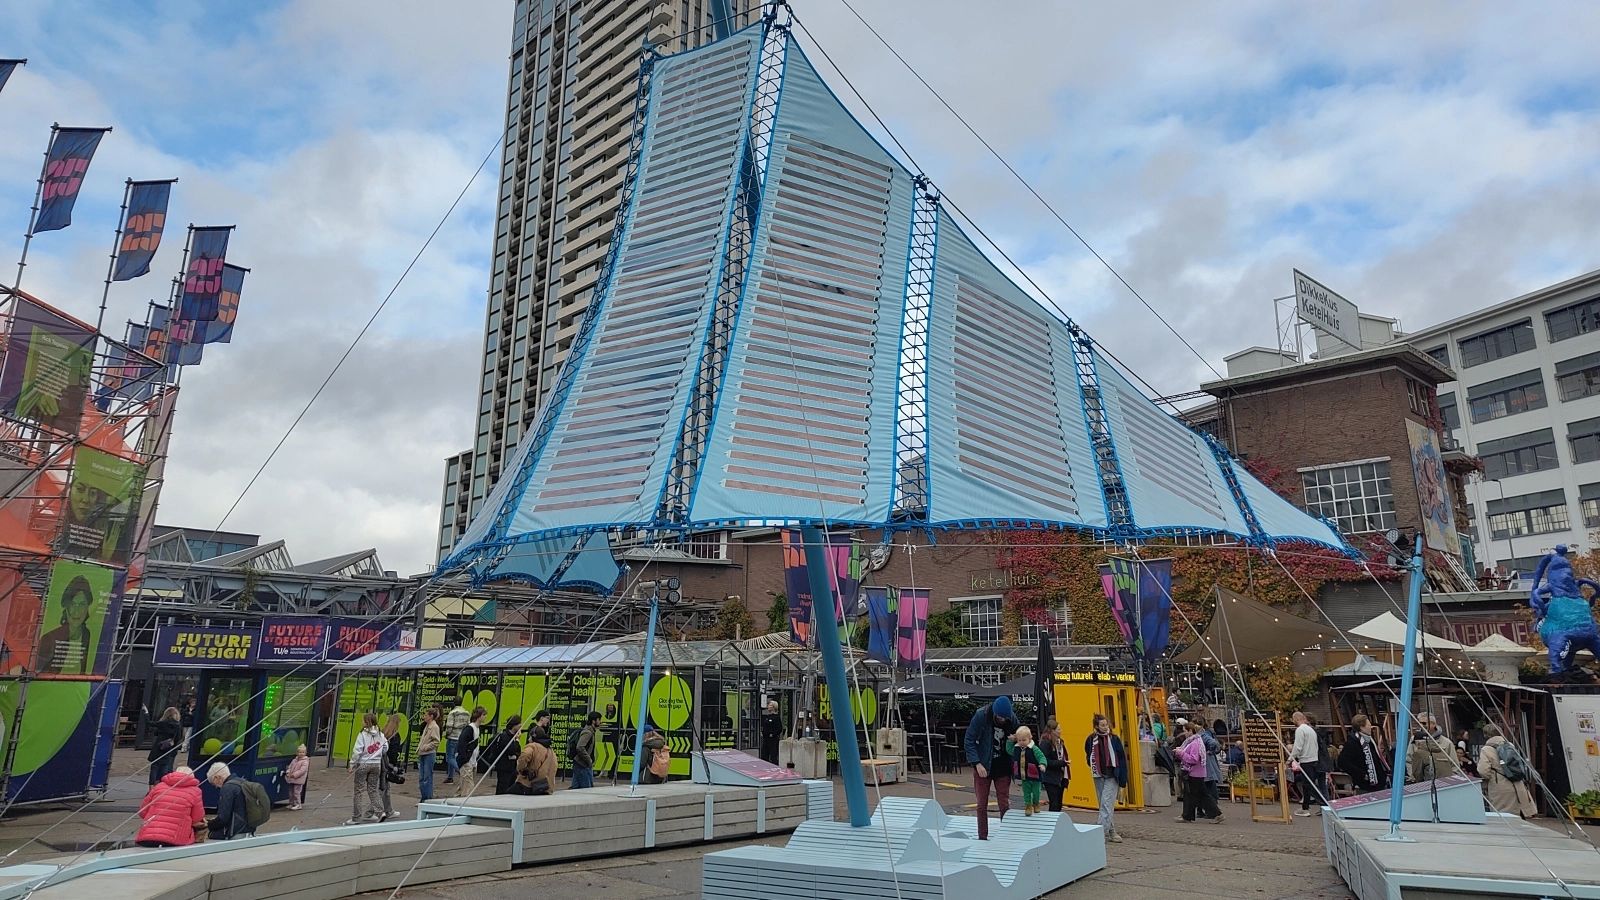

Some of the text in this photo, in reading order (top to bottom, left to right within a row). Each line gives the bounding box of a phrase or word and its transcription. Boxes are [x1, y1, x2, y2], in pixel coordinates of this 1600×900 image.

[1301, 296, 1340, 331] KetelHuis
[971, 568, 1037, 591] ketelhuis
[268, 624, 324, 637] FUTURE
[339, 625, 381, 644] FUTURE
[175, 631, 252, 648] FUTURE
[273, 636, 319, 647] DESIGN
[169, 646, 248, 660] BY DESIGN
[273, 646, 289, 656] TU/e
[343, 641, 378, 655] DESIGN
[573, 675, 621, 688] Closing the
[1054, 672, 1070, 682] waag
[377, 676, 414, 693] Unfair
[375, 691, 402, 711] Play
